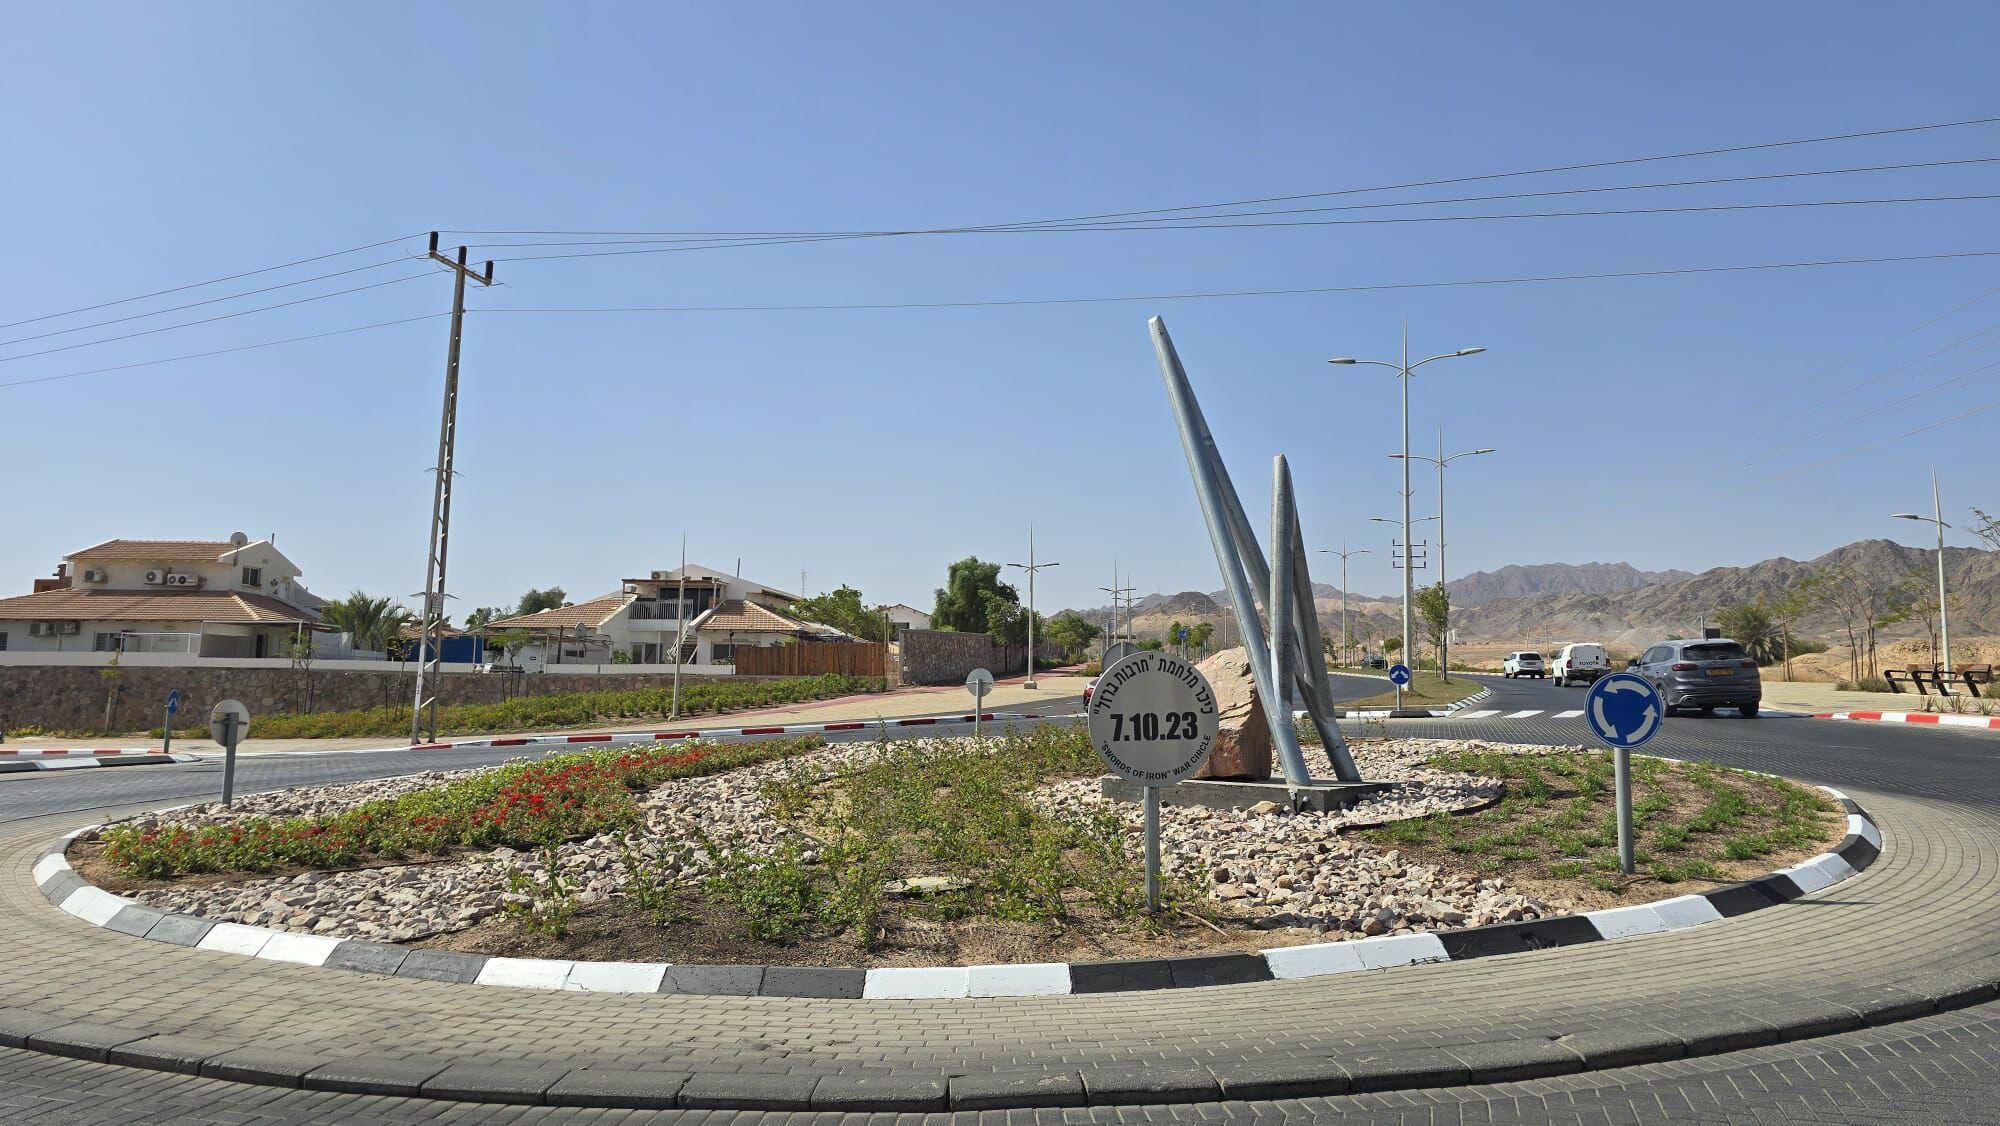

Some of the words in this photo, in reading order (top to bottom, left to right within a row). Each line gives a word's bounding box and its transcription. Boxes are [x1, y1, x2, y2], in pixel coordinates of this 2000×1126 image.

[1157, 658, 1199, 688] מלחמת
[1195, 686, 1213, 714] כיכר
[1110, 711, 1198, 742] 7.10.23
[1132, 769, 1145, 778] OF
[1172, 761, 1192, 776] WAR
[1190, 734, 1211, 764] CIRCLE
